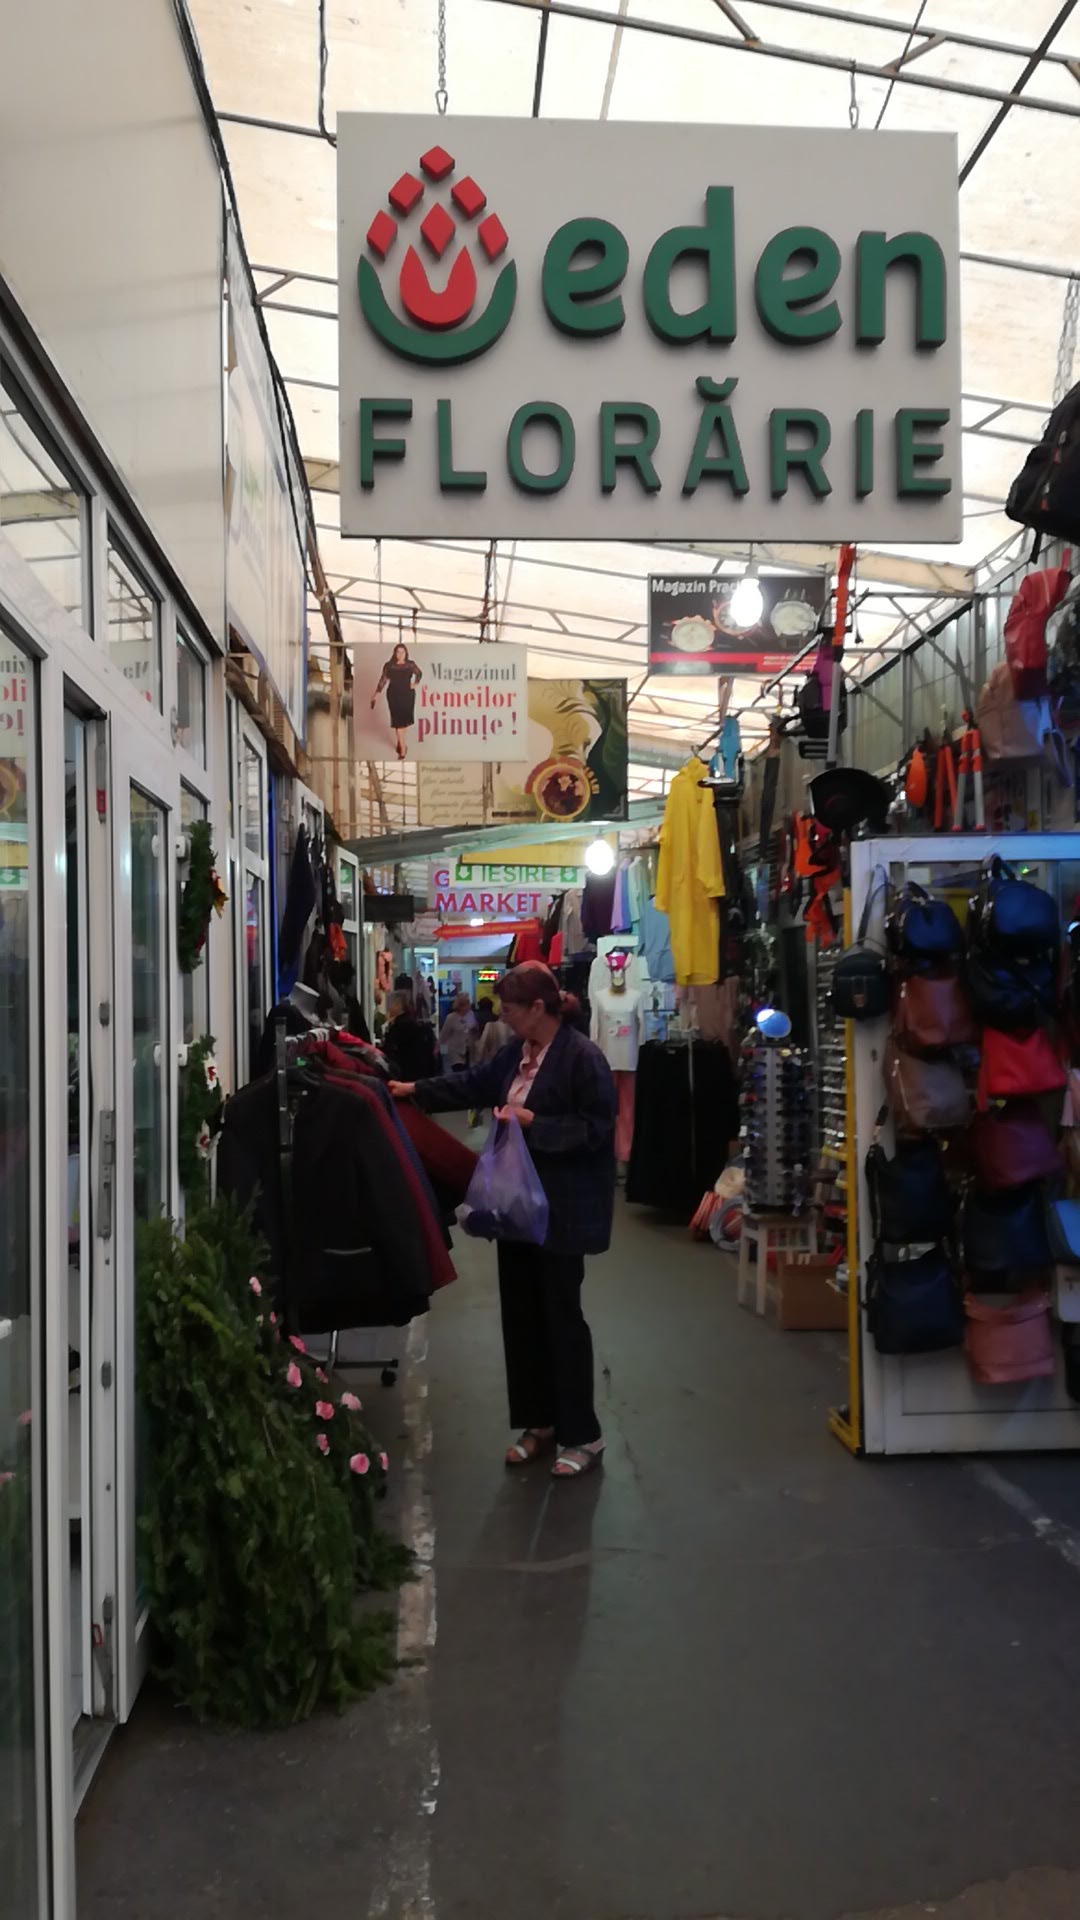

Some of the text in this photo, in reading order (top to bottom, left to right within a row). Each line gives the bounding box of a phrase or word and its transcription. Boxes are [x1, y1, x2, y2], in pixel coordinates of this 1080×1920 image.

[542, 186, 947, 349] eden
[359, 376, 952, 497] FLORĂRIE
[652, 579, 706, 596] Magazin
[431, 662, 516, 684] Magazinul
[421, 685, 517, 708] femeilor
[434, 892, 542, 912] MARKET
